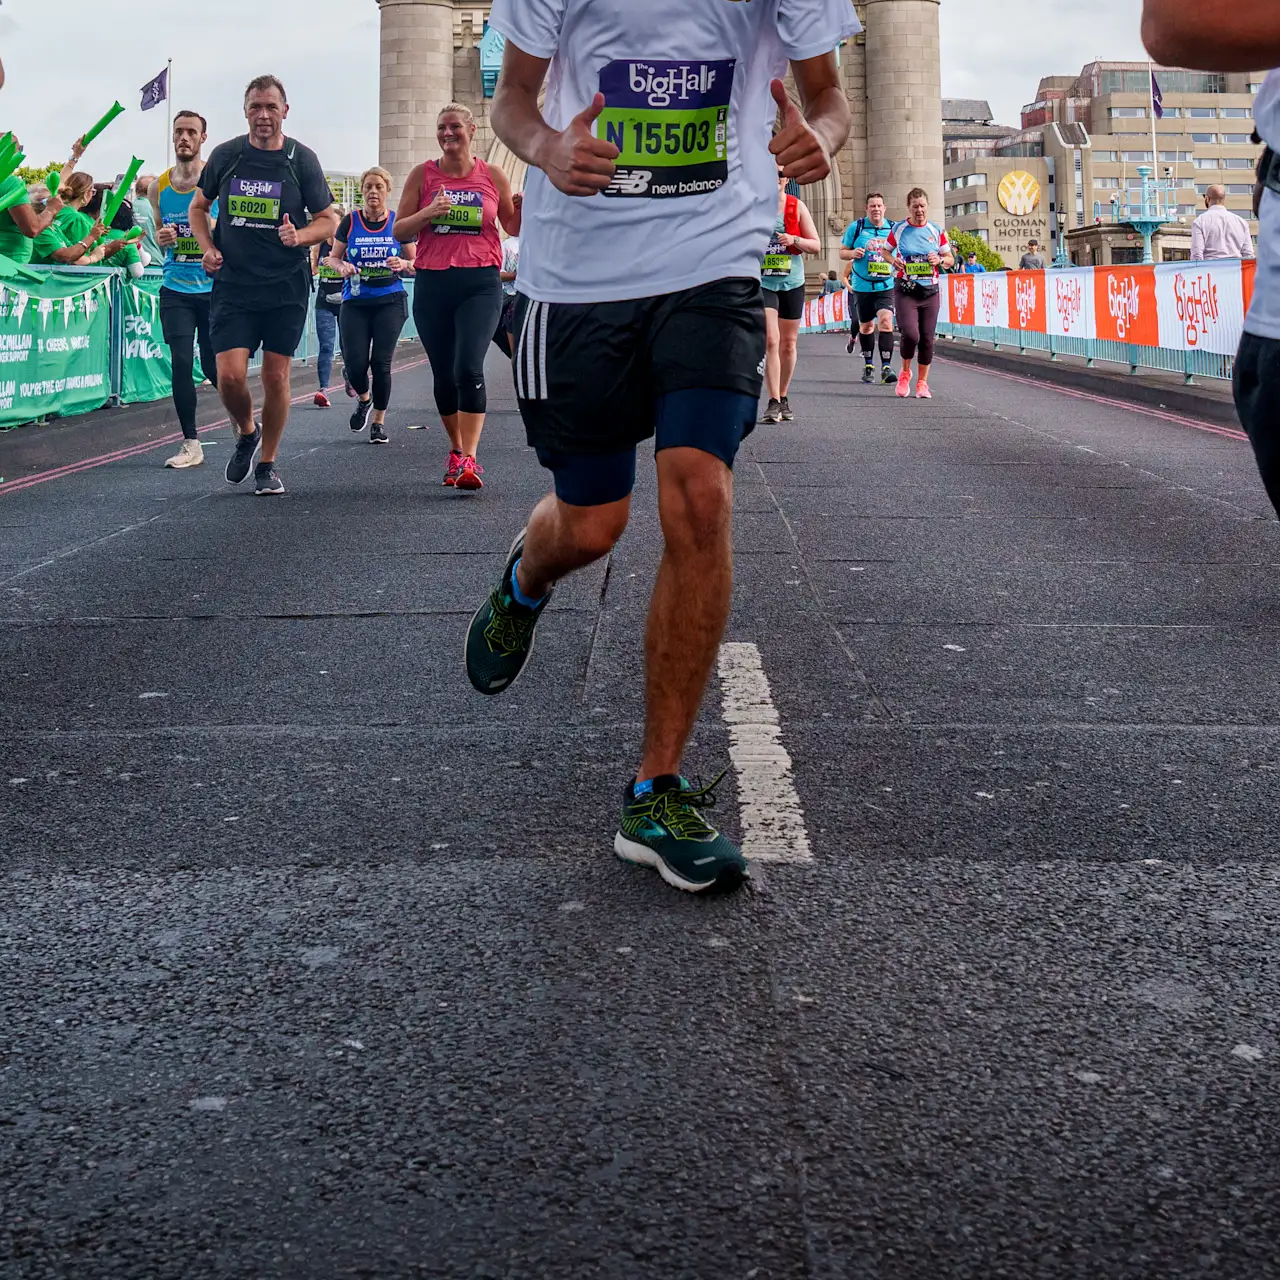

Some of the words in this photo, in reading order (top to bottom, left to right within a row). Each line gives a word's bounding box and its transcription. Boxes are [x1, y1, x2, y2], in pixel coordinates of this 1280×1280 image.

[607, 121, 624, 154] N
[633, 120, 710, 154] 15503
[605, 170, 652, 194] NB
[652, 184, 678, 194] new
[678, 179, 722, 193] balance
[232, 200, 237, 211] S
[240, 201, 266, 214] 6020
[994, 219, 1046, 227] GUOMAN
[999, 229, 1041, 237] HOTELS
[182, 241, 199, 250] 8012
[361, 247, 389, 258] ELLERY
[9, 350, 29, 362] SUPPORT
[42, 380, 55, 394] THE
